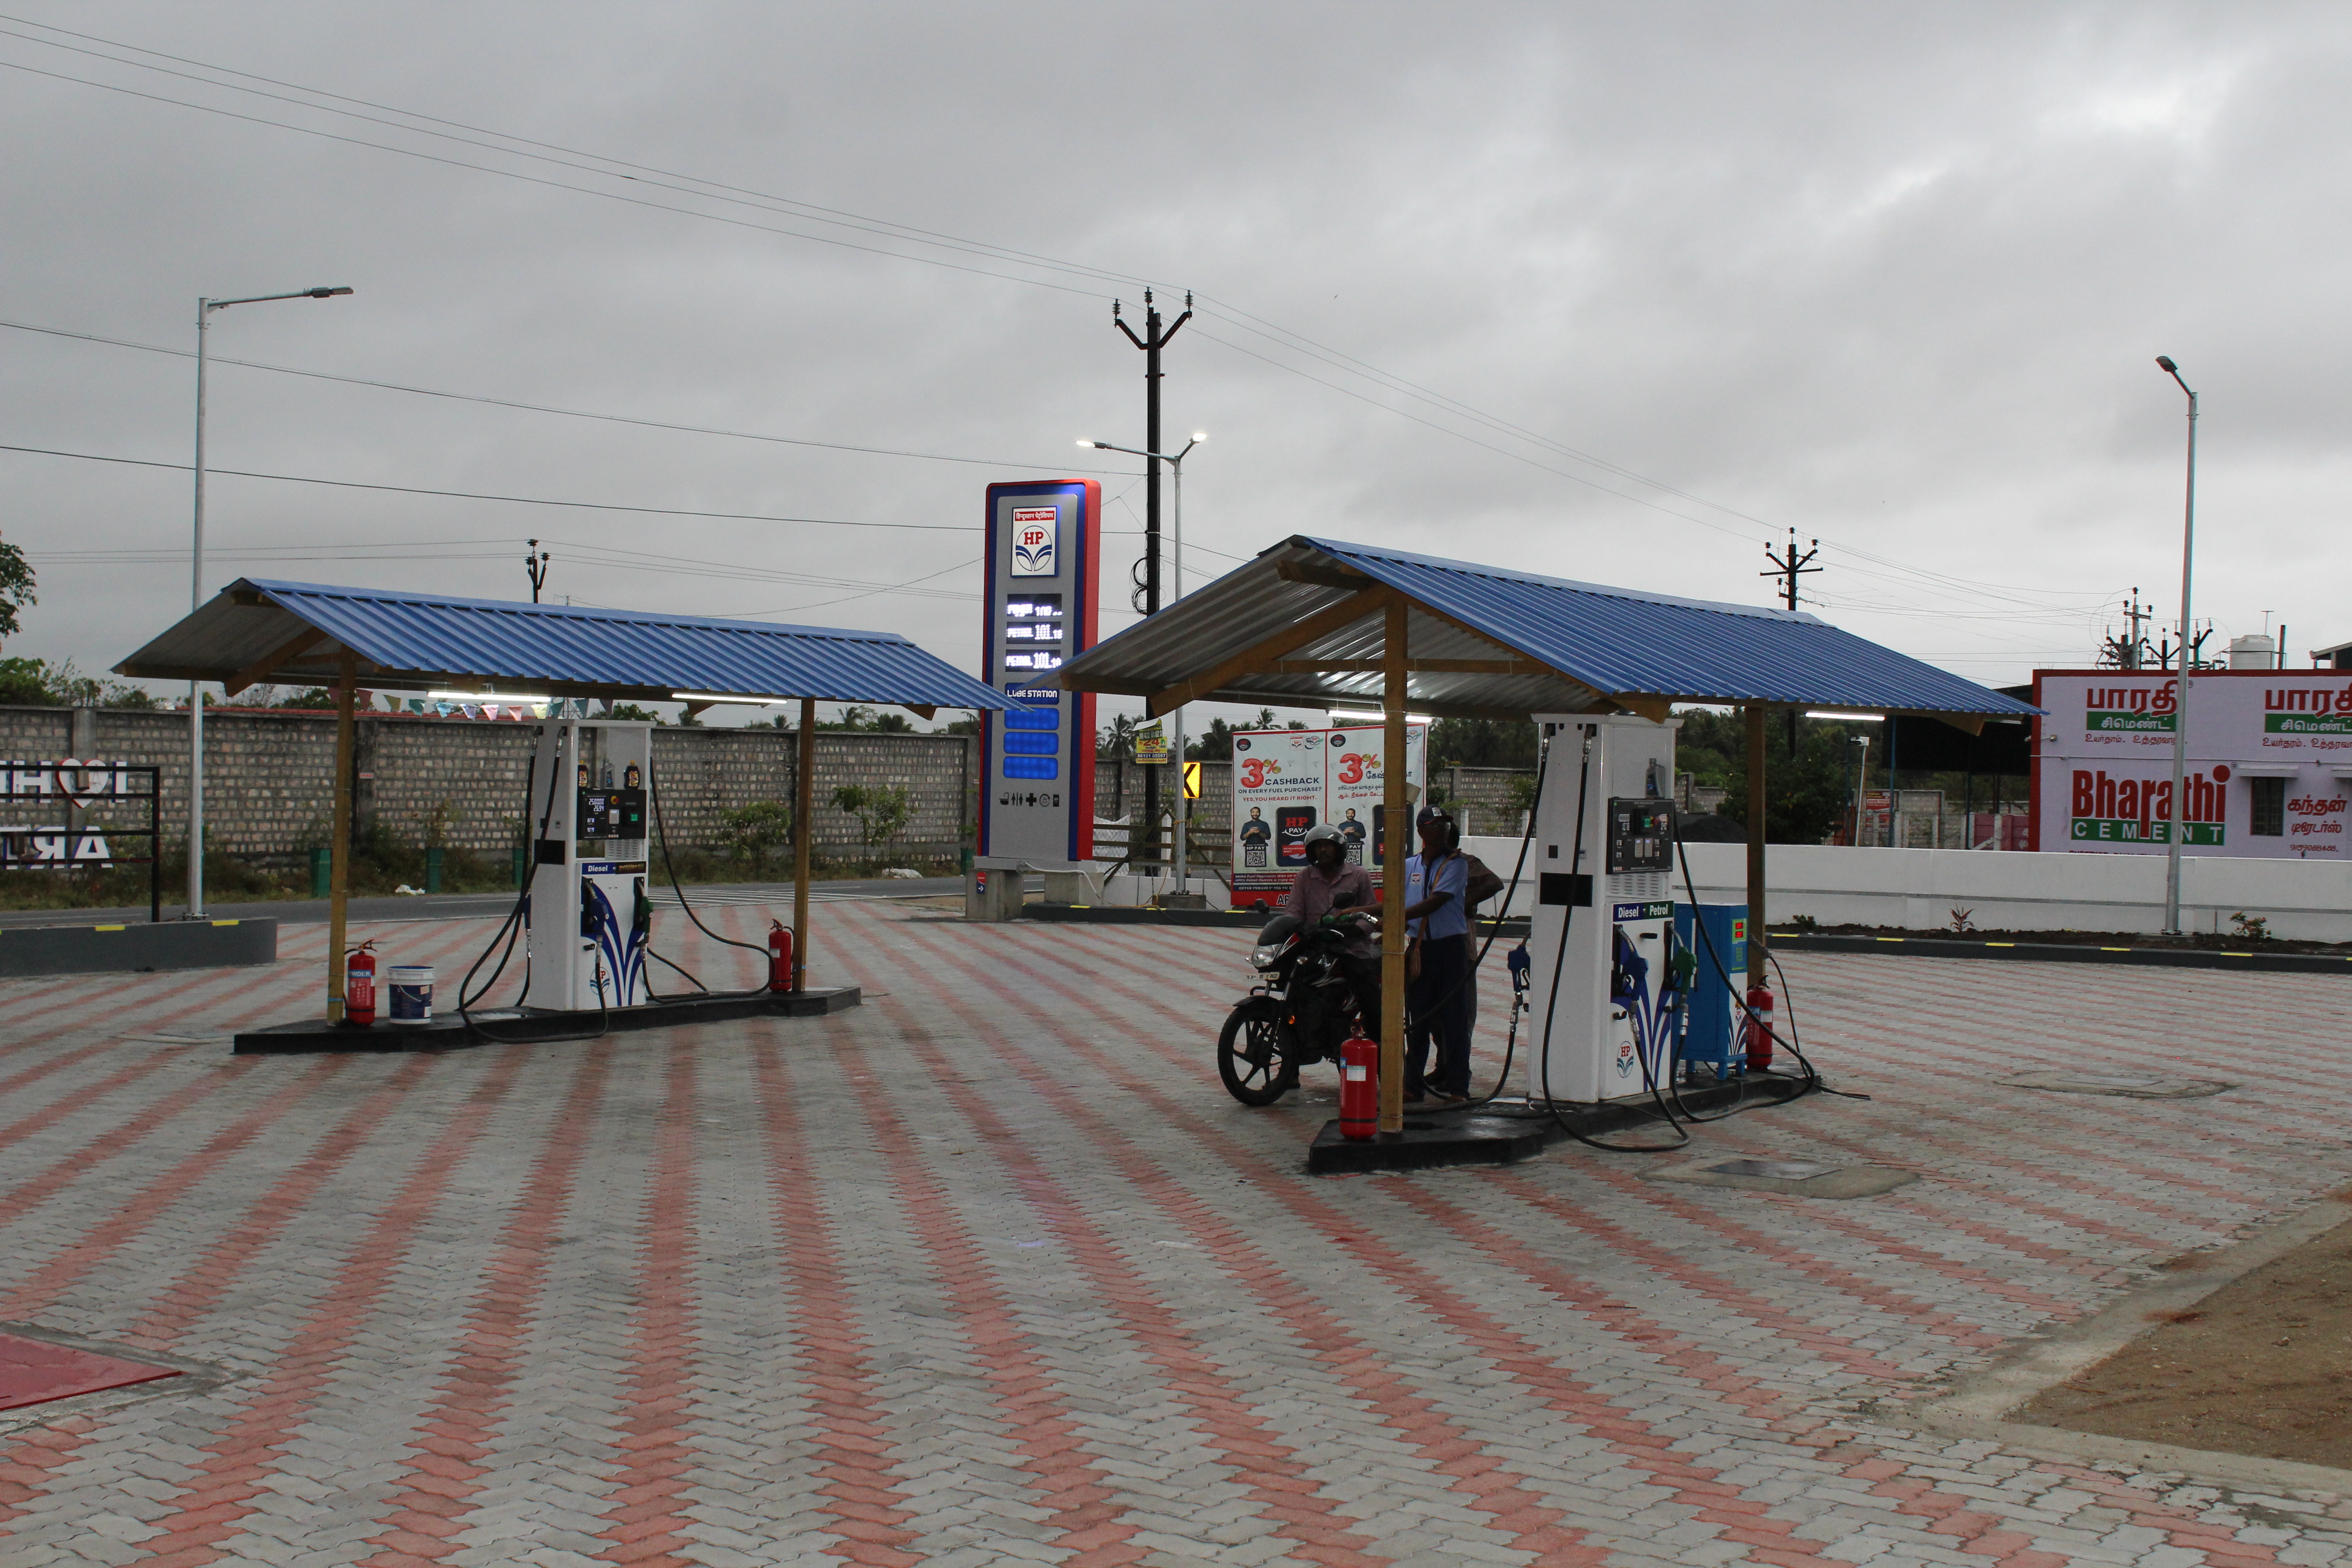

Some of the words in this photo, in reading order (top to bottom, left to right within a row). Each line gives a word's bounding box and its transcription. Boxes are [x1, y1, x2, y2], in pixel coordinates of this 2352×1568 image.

[1024, 531, 1044, 545] HP
[1006, 655, 1033, 666] PETROL
[1007, 690, 1026, 698] LUBE
[1027, 690, 1058, 699] STATION
[2087, 680, 2178, 716] பாரதி
[2101, 717, 2171, 730] சிமெண்ட்
[1265, 777, 1320, 785] CASHBACK
[2073, 765, 2230, 838] Bharathi
[2287, 794, 2347, 816] கந்தன்
[1285, 817, 1308, 827] HP
[2074, 822, 2222, 842] CEMENT
[1618, 906, 1639, 918] Diesel
[1649, 904, 1668, 916] Petrol
[1621, 1046, 1630, 1057] HP
